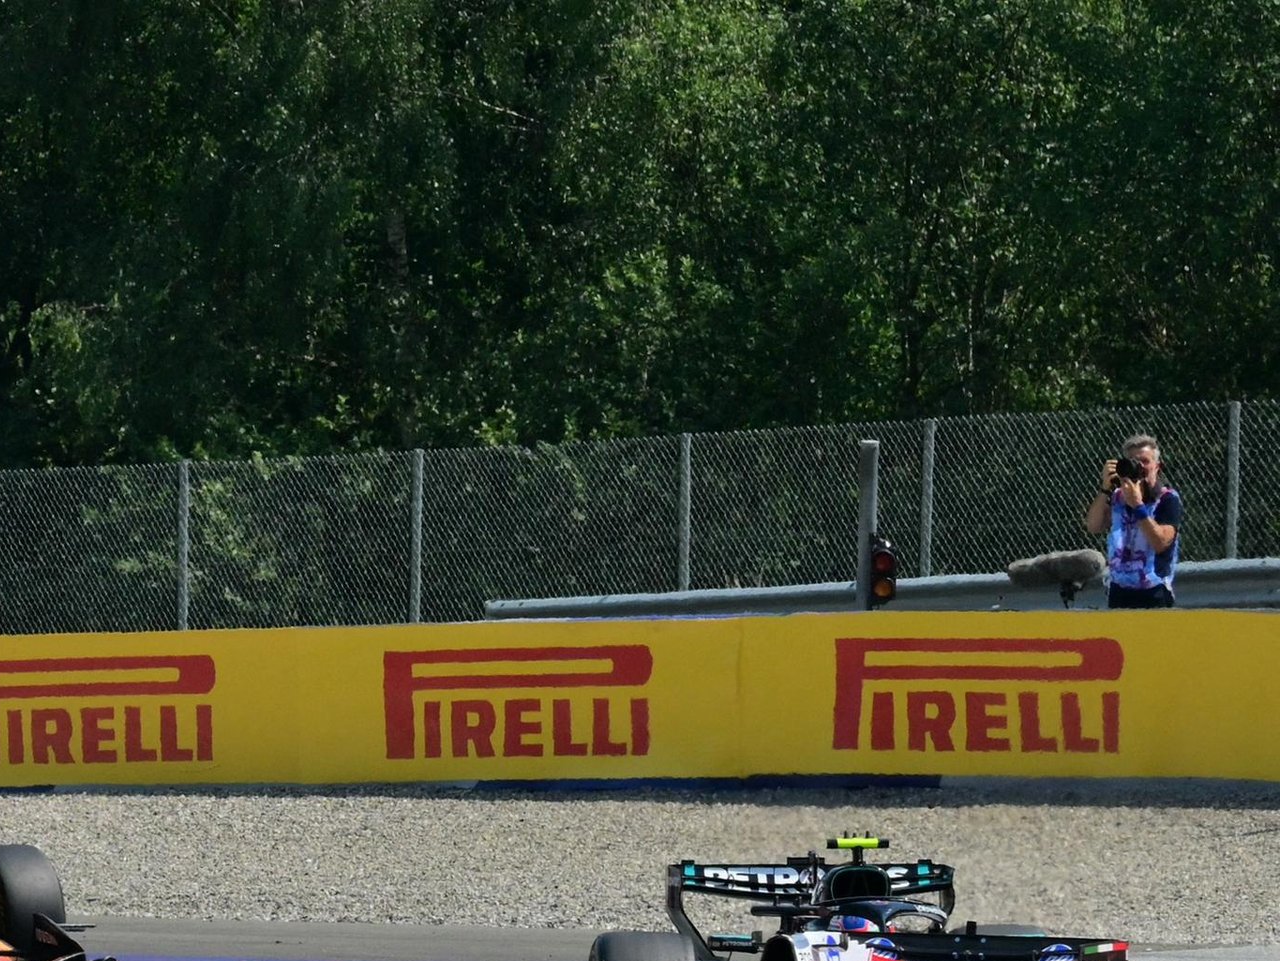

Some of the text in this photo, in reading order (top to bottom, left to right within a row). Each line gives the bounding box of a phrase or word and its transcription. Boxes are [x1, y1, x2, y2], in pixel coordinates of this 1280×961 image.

[383, 644, 654, 760] PIRELLI
[833, 637, 1125, 752] PIRELLI
[703, 865, 908, 895] PETROS
